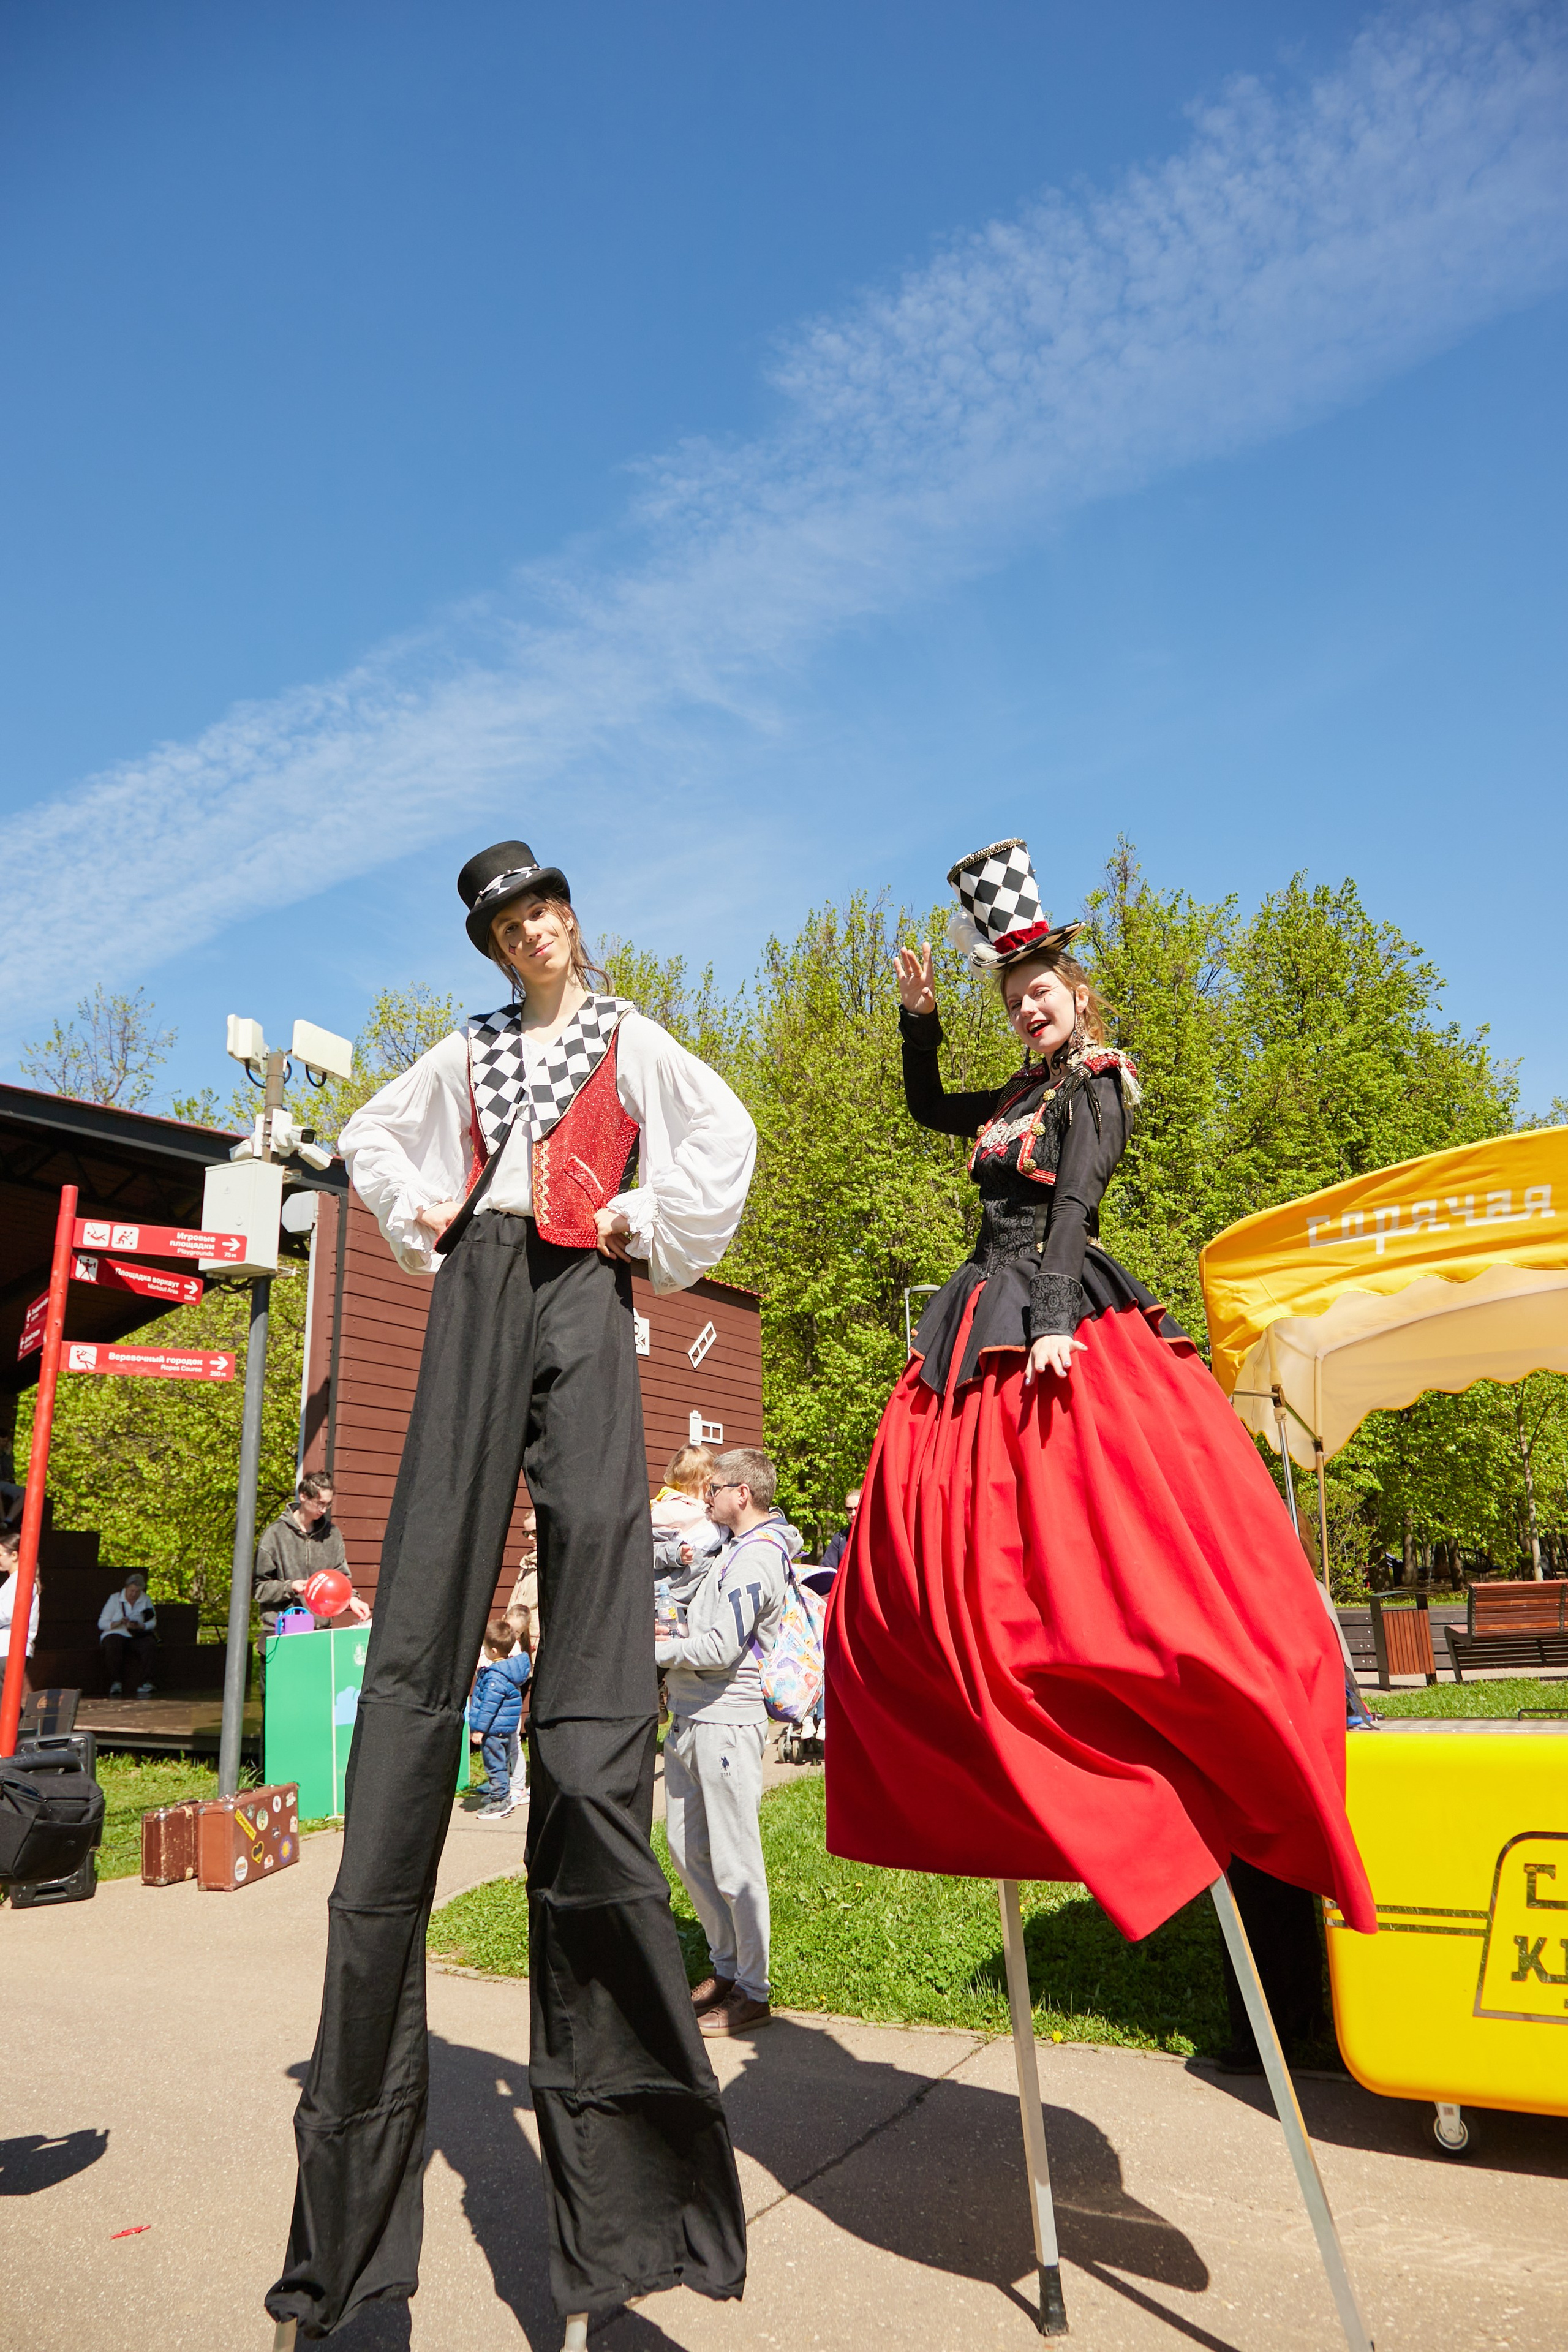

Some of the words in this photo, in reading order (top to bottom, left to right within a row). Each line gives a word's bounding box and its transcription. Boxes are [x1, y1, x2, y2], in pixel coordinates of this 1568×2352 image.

[176, 1232, 216, 1242] Игровые
[170, 1240, 215, 1250] площадки
[177, 1248, 214, 1257] Playgrounds
[115, 1267, 151, 1282] Площадка
[152, 1277, 180, 1288] воркаут
[148, 1283, 167, 1292] Workout
[108, 1352, 165, 1363] Веревочный
[166, 1357, 203, 1366] городок
